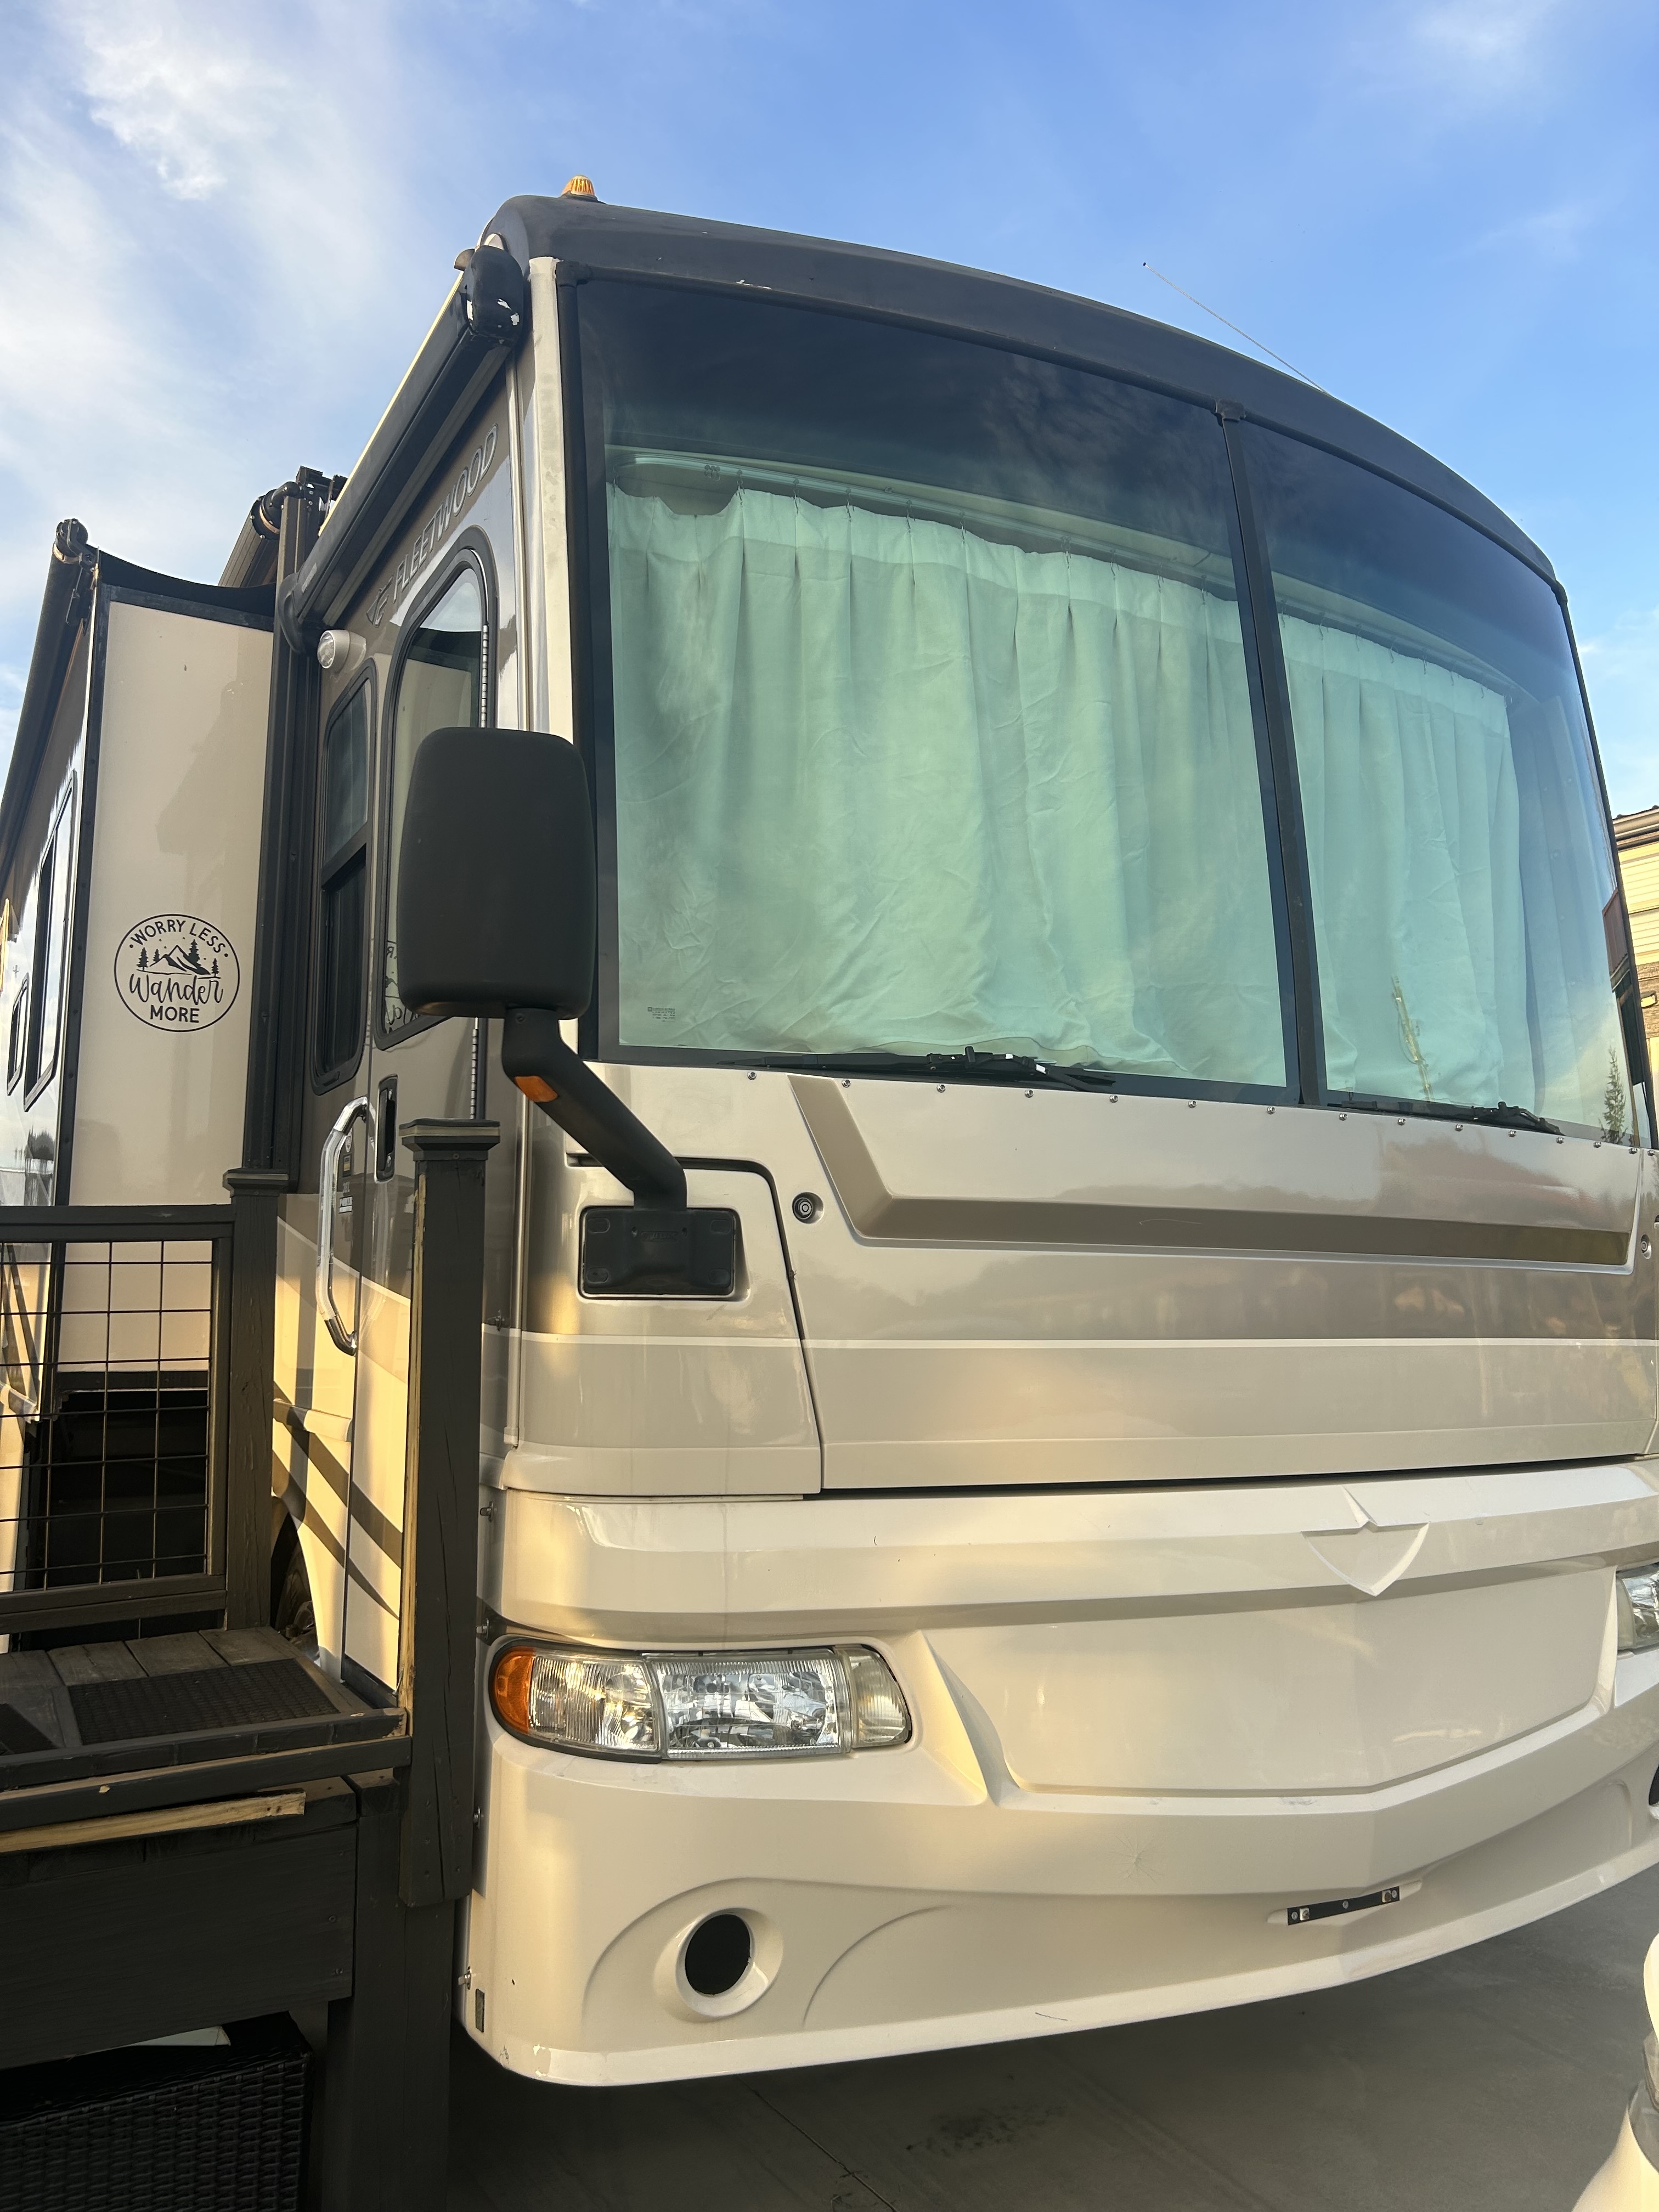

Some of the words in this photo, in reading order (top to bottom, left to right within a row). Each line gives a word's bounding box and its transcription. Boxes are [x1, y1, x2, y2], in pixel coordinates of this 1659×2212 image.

[393, 423, 499, 604] FLEETWOOD
[131, 919, 186, 945] WORRY
[189, 923, 225, 953] LESS
[129, 973, 223, 1005] Wander
[150, 1005, 200, 1023] MORE
